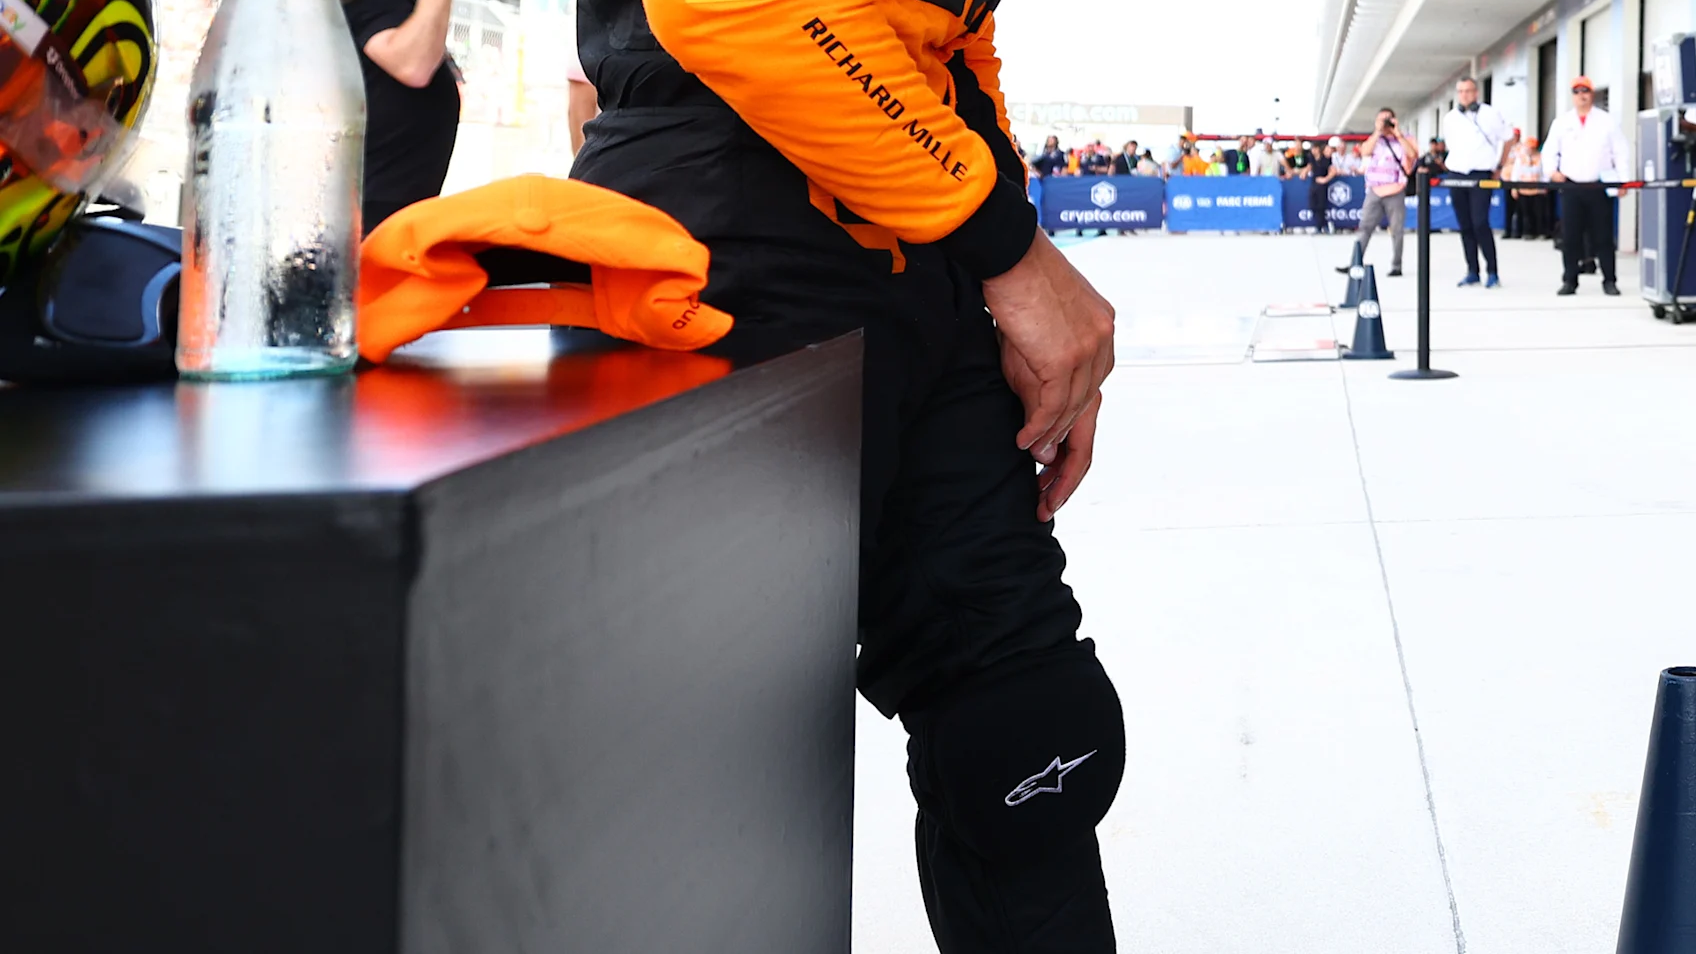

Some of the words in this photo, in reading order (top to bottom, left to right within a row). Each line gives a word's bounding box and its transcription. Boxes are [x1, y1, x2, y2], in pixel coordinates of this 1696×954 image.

[801, 16, 906, 121] RICHARD
[902, 118, 968, 182] MILLE
[1060, 208, 1147, 224] crypto.com
